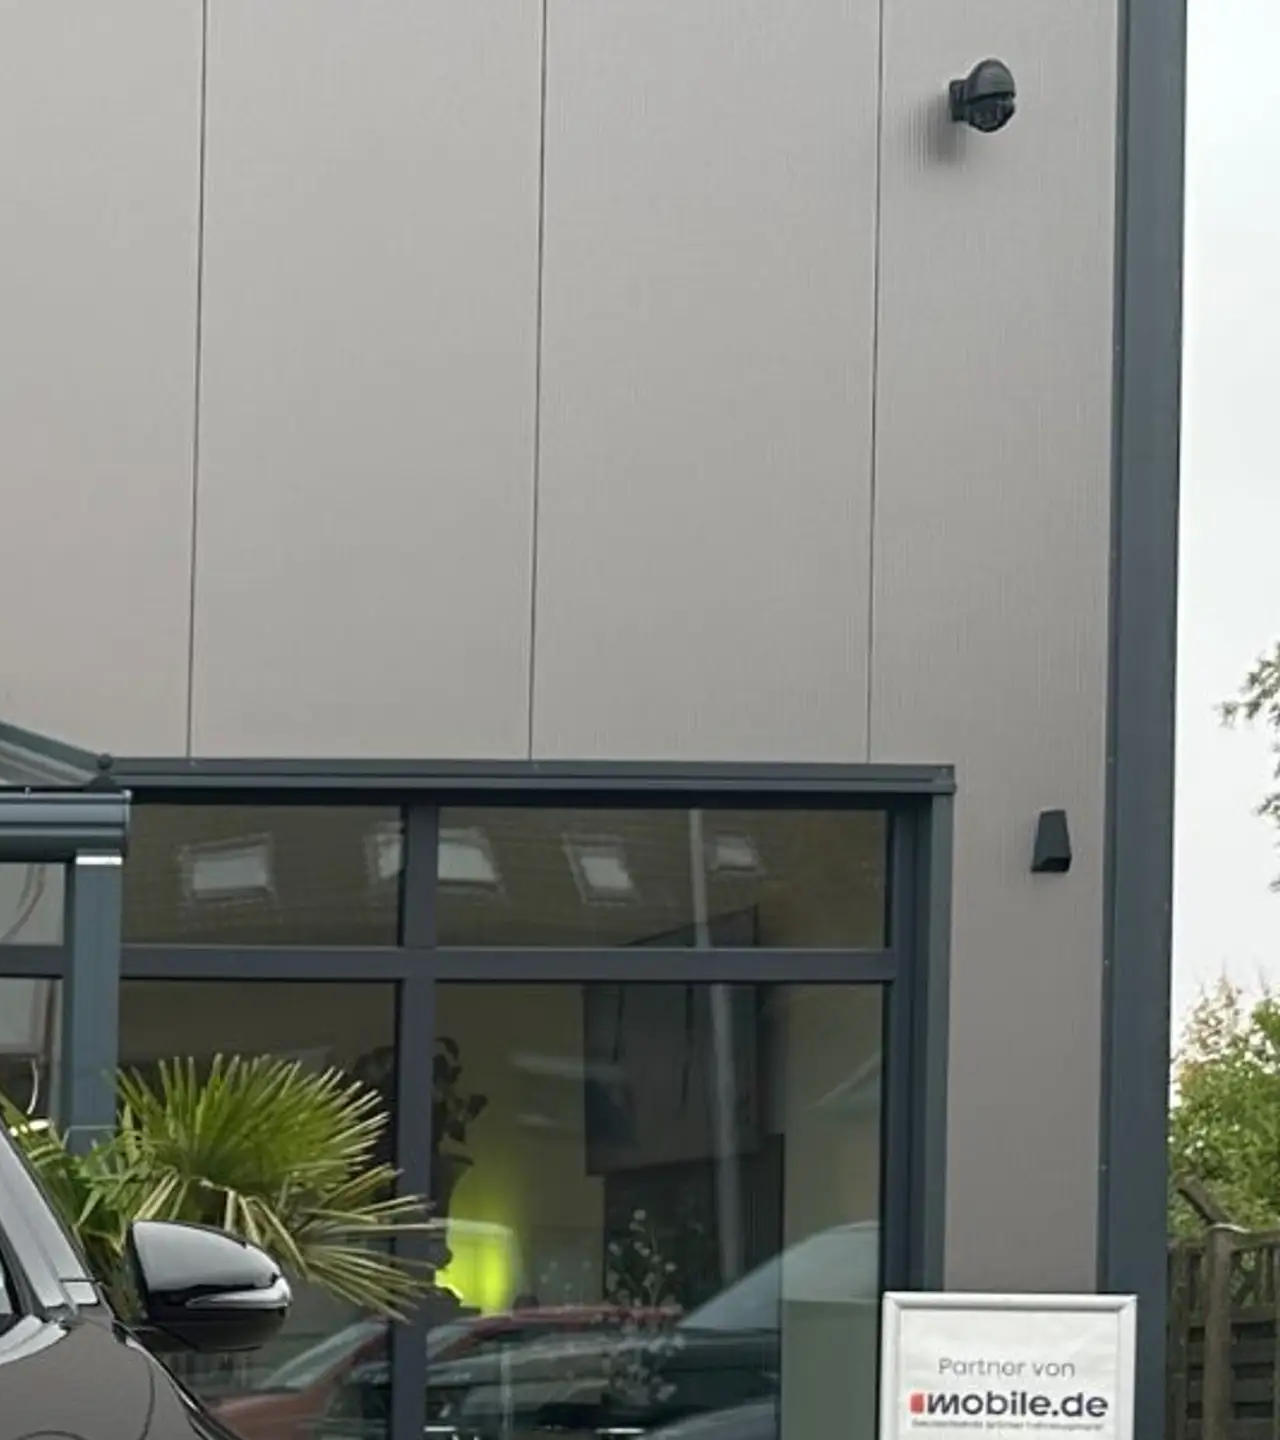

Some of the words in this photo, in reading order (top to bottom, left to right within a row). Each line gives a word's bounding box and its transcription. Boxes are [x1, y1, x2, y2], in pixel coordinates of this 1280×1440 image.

[938, 1357, 1025, 1376] Partner
[1032, 1361, 1076, 1378] von
[927, 1391, 1109, 1418] mobile.de
